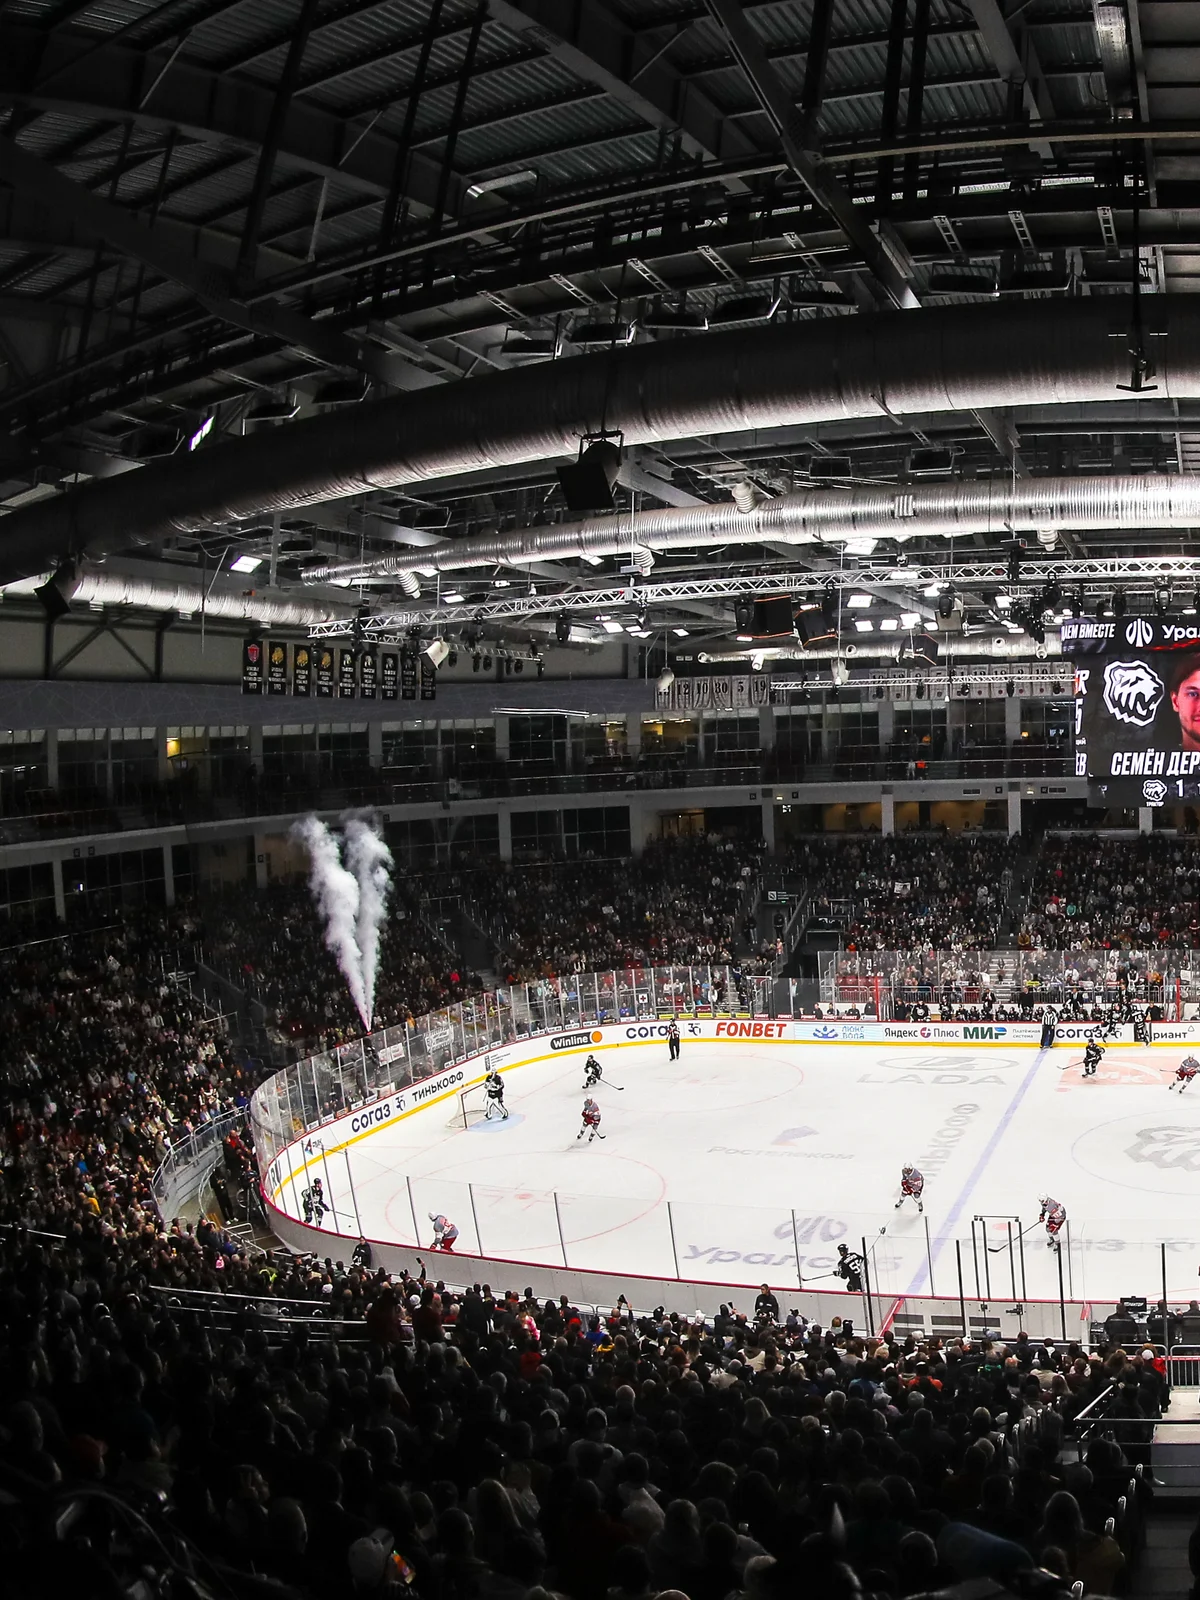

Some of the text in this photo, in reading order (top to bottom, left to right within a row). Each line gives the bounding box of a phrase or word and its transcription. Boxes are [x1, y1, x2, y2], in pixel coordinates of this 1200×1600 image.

[1078, 623, 1116, 639] ВМЕСТЕ
[1110, 748, 1165, 776] СЕМЁН
[1175, 779, 1184, 797] 1
[626, 1025, 668, 1039] сога
[716, 1022, 787, 1038] FONBET
[885, 1028, 960, 1039] Яндекс Плюс
[963, 1026, 1007, 1040] МИР
[553, 1036, 589, 1049] Winline
[412, 1071, 464, 1102] ТИНЬКОФФ
[857, 1074, 1007, 1085] LADA
[707, 1146, 855, 1160] Ростелеком
